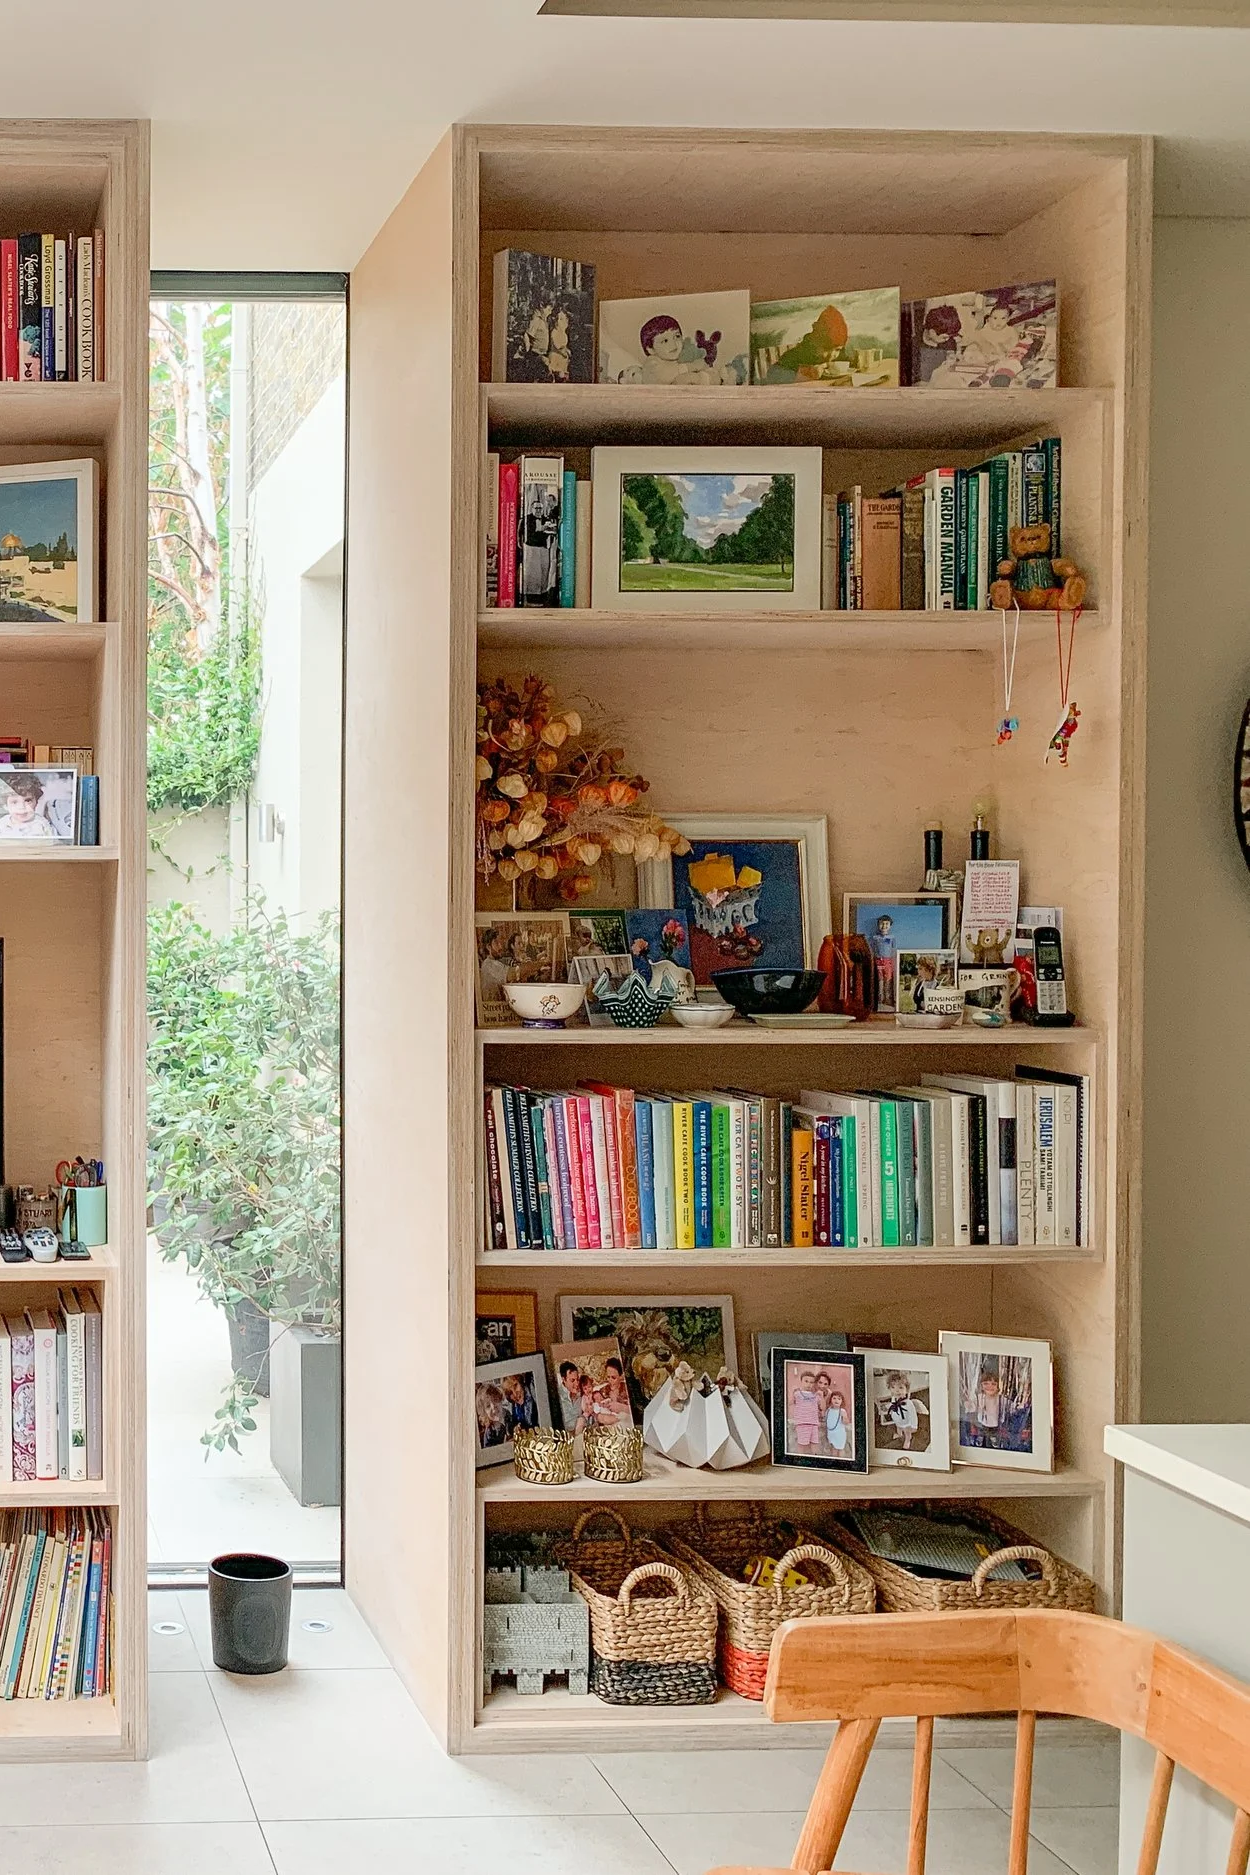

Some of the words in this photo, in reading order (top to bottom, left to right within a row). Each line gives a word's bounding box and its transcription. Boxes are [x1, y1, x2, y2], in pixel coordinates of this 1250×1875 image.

[44, 245, 53, 263] Loyd
[83, 242, 91, 260] Lady
[83, 262, 91, 298] Maclean's
[82, 298, 92, 337] COOK
[82, 340, 92, 379] BOOK
[940, 486, 954, 537] GARDEN
[1028, 486, 1037, 513] PLANTS
[940, 542, 954, 596] MANUAL
[505, 1090, 514, 1112] DELIA
[518, 1093, 528, 1114] DELIA
[1063, 1094, 1072, 1125] NOPI
[486, 1109, 494, 1128] real
[506, 1112, 516, 1140] SMITH'S
[520, 1114, 530, 1142] SMITH'S
[554, 1102, 564, 1138] barefoot
[568, 1103, 577, 1136] barefoot
[699, 1110, 707, 1123] THE
[1039, 1096, 1053, 1147] JERUSALEM
[571, 1134, 581, 1162] contessa
[583, 1122, 592, 1152] barefoot
[605, 1123, 615, 1145] garten
[699, 1125, 707, 1146] RIVER
[489, 1132, 499, 1180] chocolate
[509, 1140, 519, 1170] SUMMER
[523, 1142, 534, 1170] WINTER
[557, 1139, 566, 1170] contessa
[586, 1153, 594, 1185] contessa
[609, 1150, 617, 1170] make
[799, 1151, 810, 1181] Nigel
[512, 1170, 524, 1213] COLLECTION
[526, 1170, 538, 1213] COLLECTION
[559, 1171, 571, 1207] foolproof
[588, 1186, 595, 1194] at
[626, 1165, 638, 1227] COOKBOOK
[700, 1187, 708, 1207] BOOK
[801, 1184, 810, 1221] Slater
[1020, 1160, 1032, 1220] PLENTY
[589, 1196, 597, 1215] home
[71, 1318, 79, 1362] COOKING
[71, 1364, 79, 1383] FOR
[72, 1386, 80, 1425] FRIENDS
[37, 1551, 51, 1589] LEONARDO
[37, 1590, 44, 1599] DA
[32, 1600, 42, 1620] VINCI
